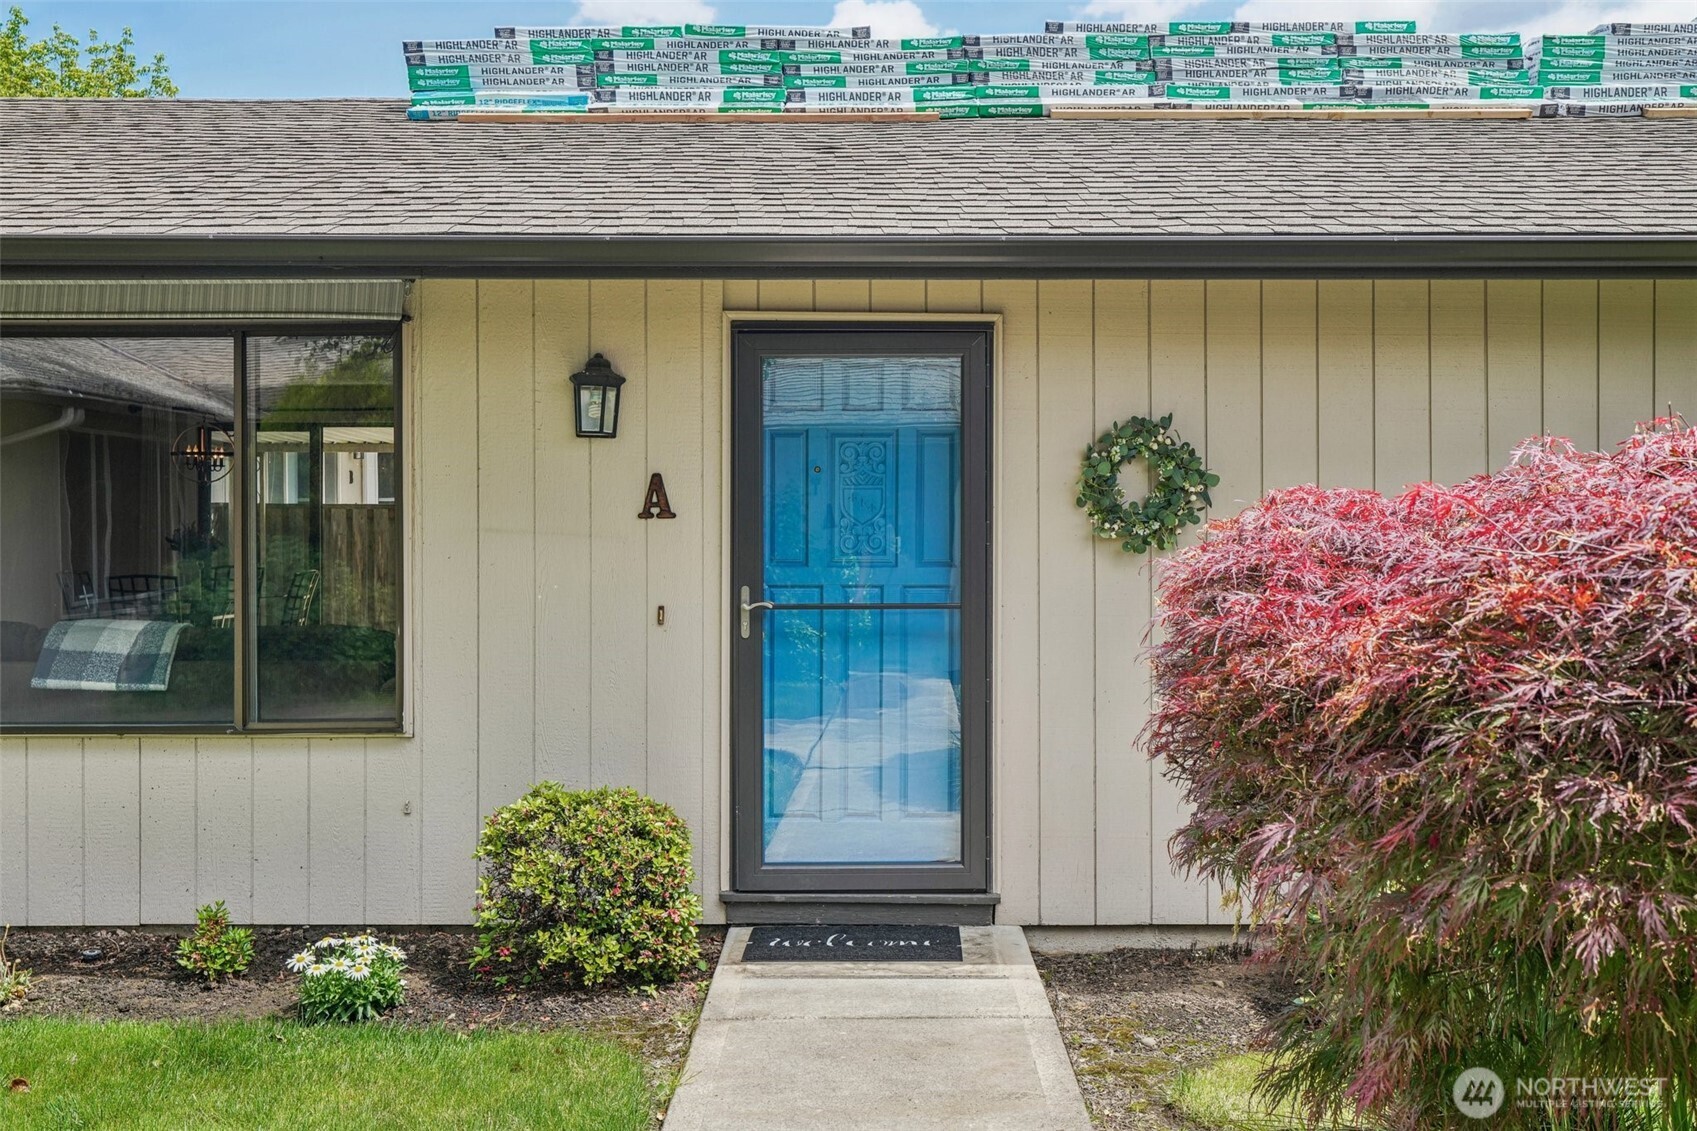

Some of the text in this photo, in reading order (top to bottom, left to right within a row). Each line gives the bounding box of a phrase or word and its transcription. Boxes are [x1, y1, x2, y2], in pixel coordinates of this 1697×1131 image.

[1144, 24, 1157, 33] AR
[1330, 22, 1344, 31] AR
[597, 29, 610, 38] AR
[876, 39, 889, 48] AR
[1060, 36, 1074, 44] AR
[1246, 36, 1260, 45] AR
[504, 40, 518, 50] AR
[1064, 48, 1078, 57] AR
[1437, 46, 1450, 54] AR
[507, 54, 521, 63] AR
[693, 51, 707, 60] AR
[921, 51, 935, 59] AR
[695, 63, 708, 72] AR
[881, 65, 894, 73] AR
[1070, 72, 1084, 80] AR
[1313, 87, 1327, 95] AR
[1455, 88, 1468, 96] AR
[1654, 87, 1667, 97] AR
[698, 91, 711, 101] AR
[888, 92, 901, 101] AR
[638, 473, 676, 519] A
